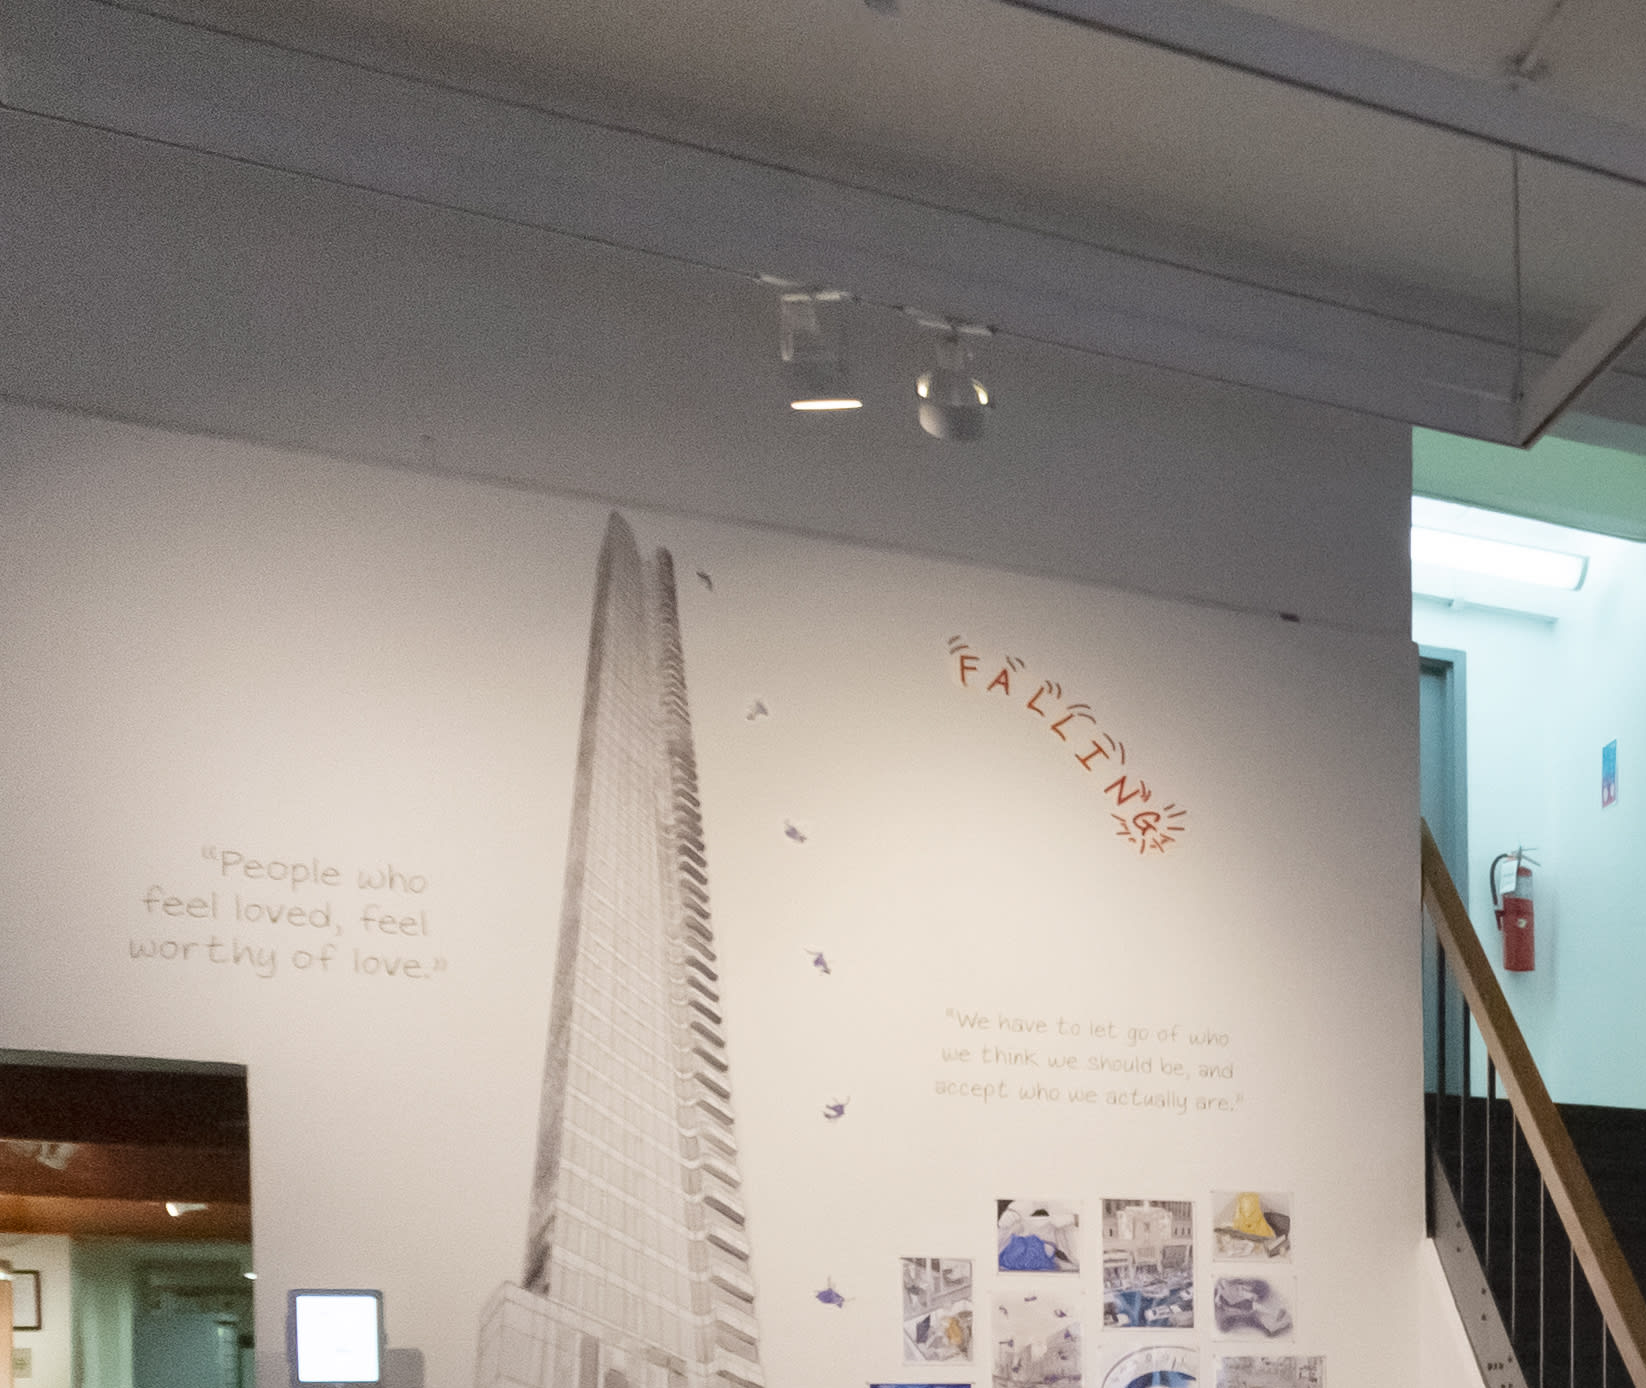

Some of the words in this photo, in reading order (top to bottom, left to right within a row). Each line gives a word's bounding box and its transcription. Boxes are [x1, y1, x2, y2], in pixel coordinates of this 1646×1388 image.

[958, 653, 1161, 838] FALLING
[357, 864, 428, 894] who
[143, 884, 218, 919] feel
[235, 895, 343, 936] loved,
[360, 904, 428, 936] feel
[129, 935, 276, 979] worthy
[292, 943, 336, 972] of
[999, 1011, 1048, 1033] have
[1056, 1016, 1081, 1036] to
[1090, 1020, 1118, 1040] let
[1128, 1026, 1149, 1047] go
[1157, 1023, 1183, 1042] of
[1189, 1028, 1230, 1047] who
[942, 1047, 971, 1063] we
[982, 1046, 1039, 1067] think
[1048, 1055, 1078, 1070] we
[1088, 1054, 1153, 1074] should
[1160, 1057, 1191, 1080] be,
[1199, 1062, 1234, 1081] and
[935, 1080, 1008, 1104] accept
[1019, 1083, 1060, 1102] who
[1068, 1088, 1097, 1103] we
[1105, 1090, 1188, 1115] actually
